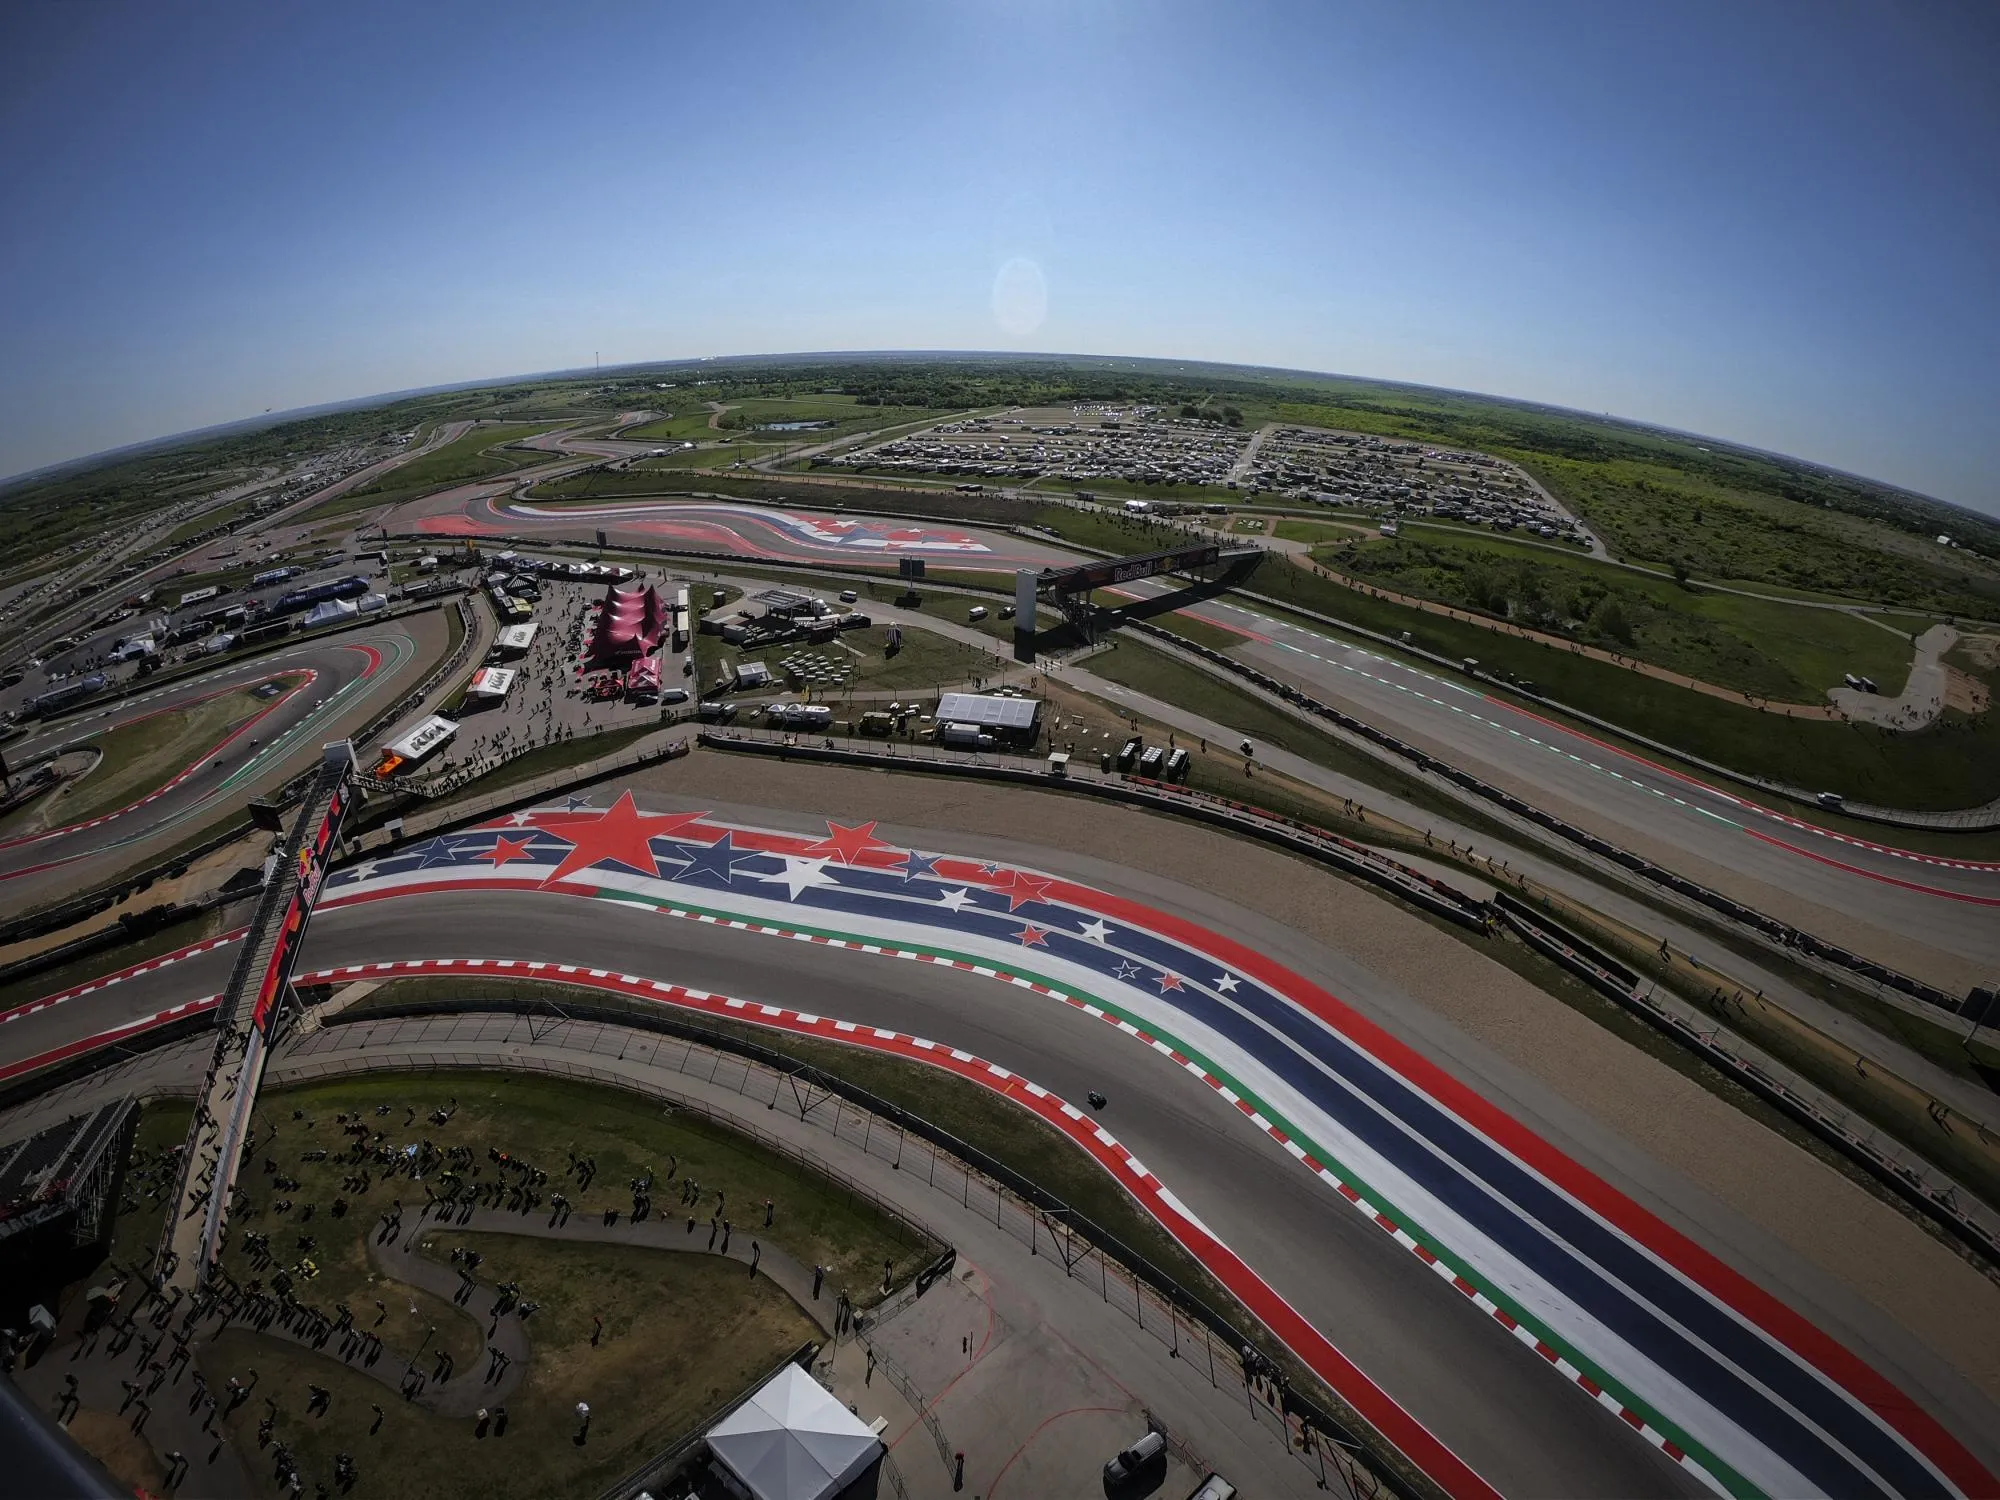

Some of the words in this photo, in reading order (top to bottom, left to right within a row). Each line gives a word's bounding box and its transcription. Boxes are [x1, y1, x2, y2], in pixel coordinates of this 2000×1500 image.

[1114, 564, 1135, 582] Red
[1135, 561, 1153, 578] Bull
[487, 672, 507, 690] KTM
[410, 724, 447, 752] KTM
